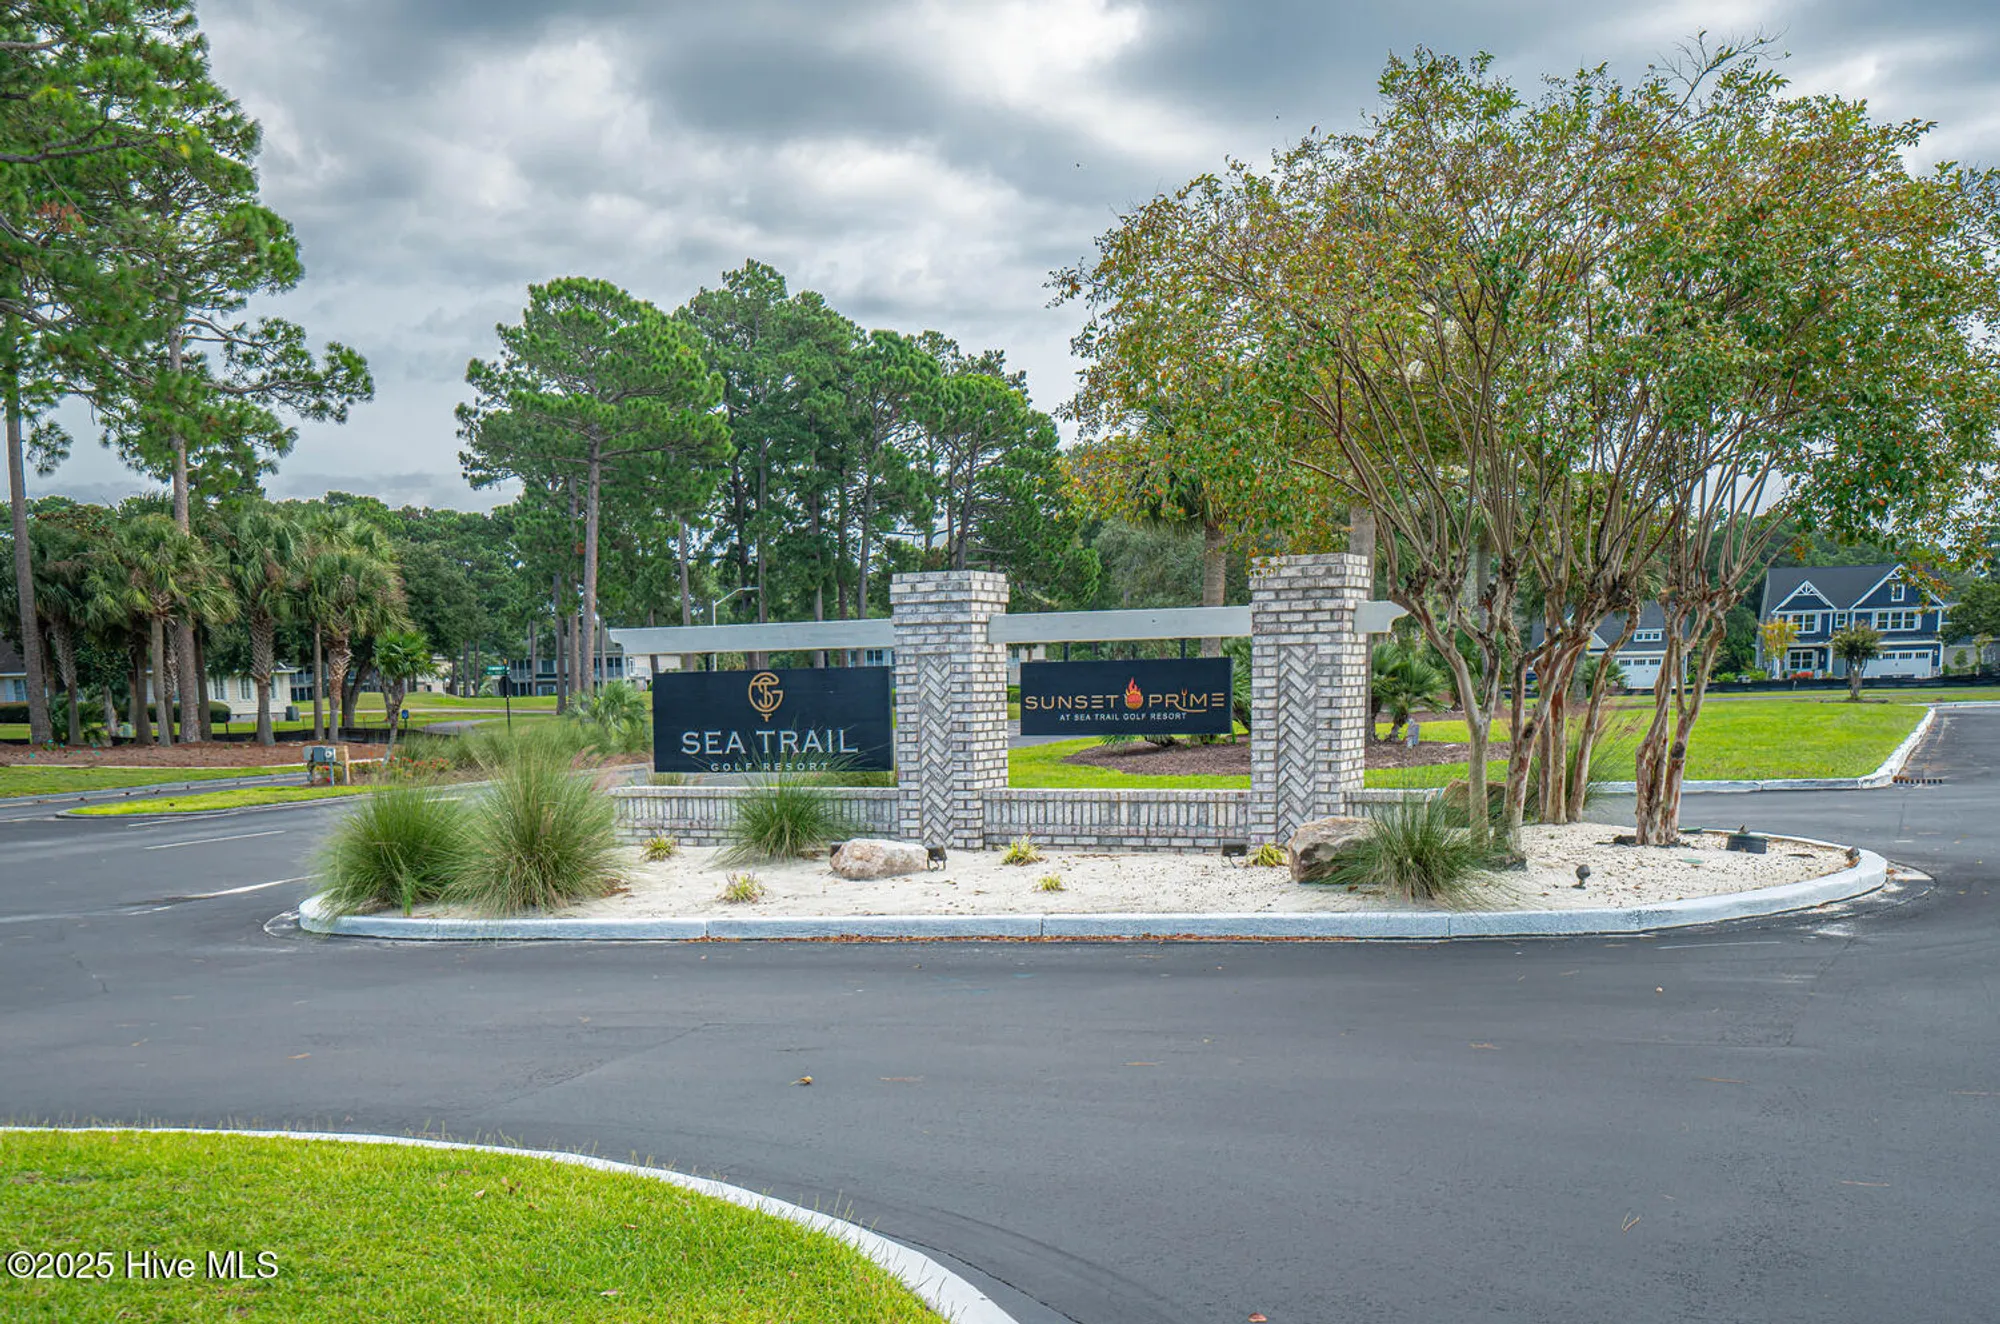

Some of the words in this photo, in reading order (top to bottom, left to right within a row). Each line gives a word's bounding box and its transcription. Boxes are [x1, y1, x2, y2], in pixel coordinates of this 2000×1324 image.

[1024, 695, 1119, 710] SUNSET
[1149, 688, 1225, 713] PRIME
[1094, 713, 1119, 721] TRAIL
[1123, 713, 1146, 721] GOLF
[1150, 712, 1187, 720] RESORT
[681, 730, 747, 755] SEA
[755, 729, 859, 754] TRAIL
[710, 762, 753, 772] GOLF
[763, 762, 829, 771] RESORT
